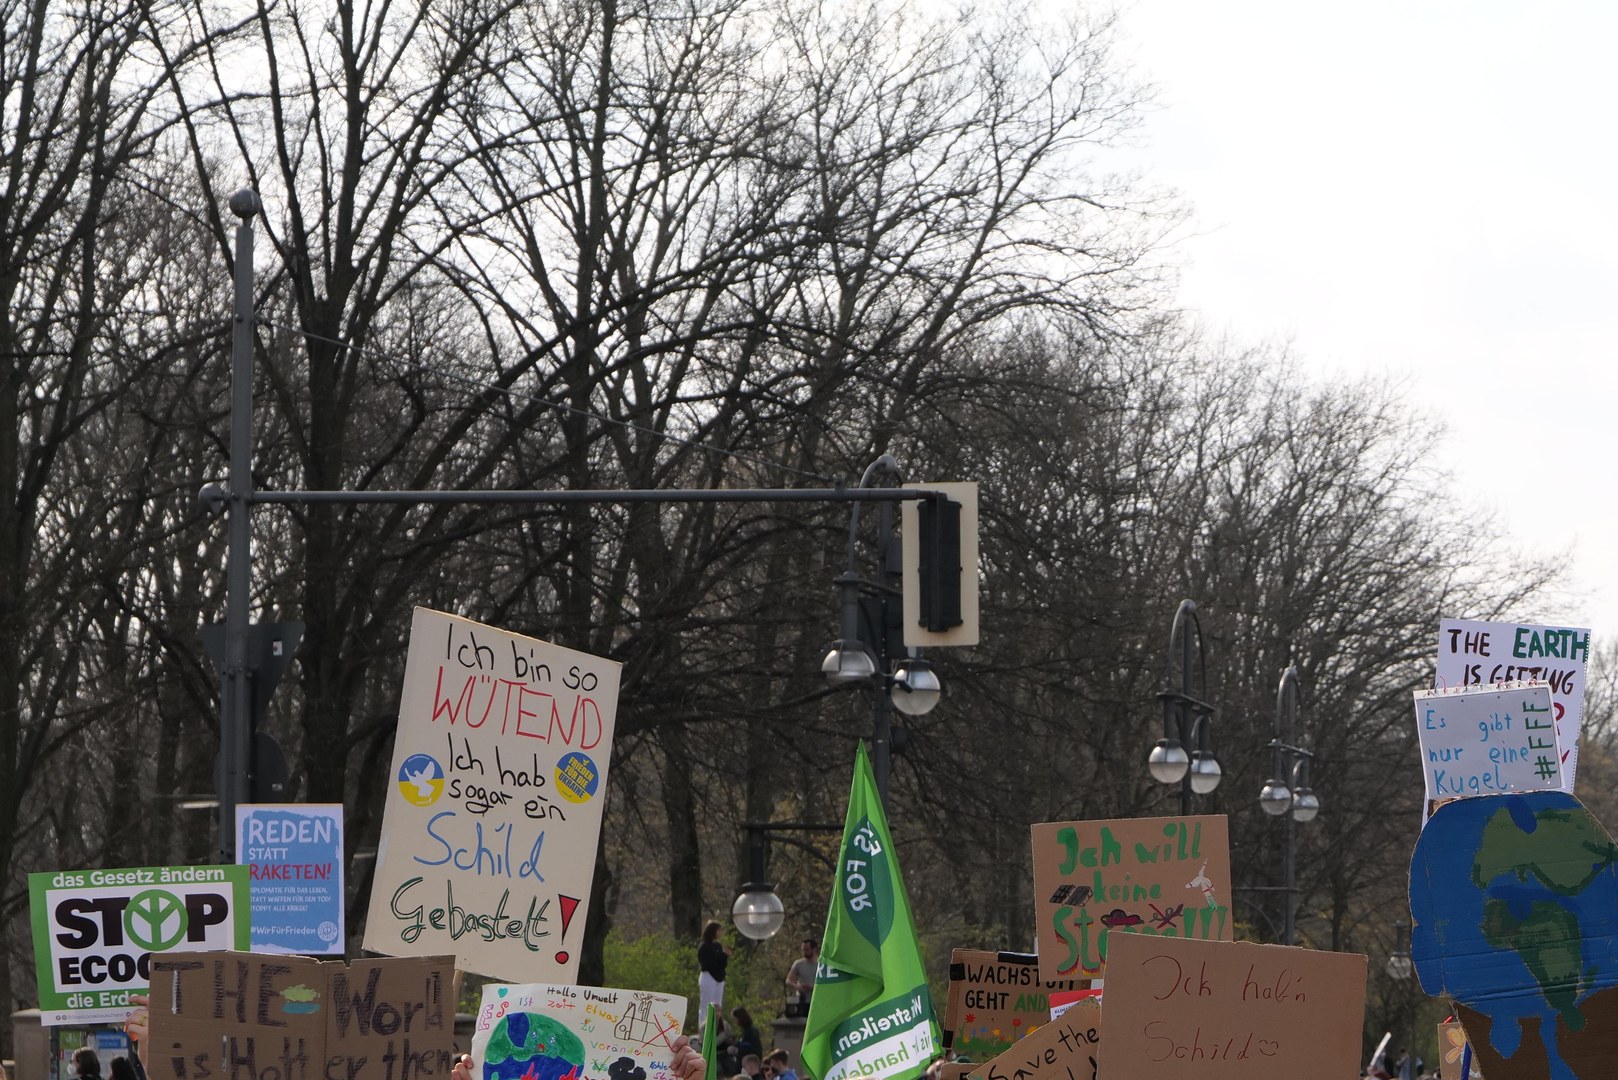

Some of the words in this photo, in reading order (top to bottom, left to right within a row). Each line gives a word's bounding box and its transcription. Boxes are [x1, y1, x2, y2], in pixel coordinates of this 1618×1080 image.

[447, 623, 494, 670] Ich
[511, 640, 551, 683] bin
[562, 665, 599, 692] so
[1448, 629, 1490, 657] THE
[1512, 627, 1589, 663] EARTH
[432, 666, 602, 750] WÜTEND
[1426, 710, 1446, 730] Es
[1478, 712, 1513, 742] gibt
[1523, 701, 1557, 780] #FFF
[447, 732, 484, 776] Ich
[495, 745, 546, 787] hab
[1428, 747, 1464, 762] nur
[1488, 741, 1529, 763] eine
[1433, 764, 1508, 795] Kugel
[524, 795, 566, 821] ein
[248, 819, 331, 845] REDEN
[413, 811, 545, 883] Schild
[1134, 821, 1201, 863] will
[248, 848, 288, 860] STATT
[52, 871, 84, 888] das
[90, 869, 154, 885] Gesetz
[160, 867, 225, 883] ändern
[249, 863, 332, 880] RAKETEN!
[1093, 870, 1162, 904] keine
[55, 889, 229, 950] STOP
[66, 994, 94, 1008] die
[153, 960, 291, 1028] THE
[547, 986, 577, 999] Hallo
[584, 990, 619, 1004] Umwelt
[965, 990, 1010, 1011] GEHT
[1058, 1024, 1100, 1053] the
[1144, 1021, 1254, 1062] Schild
[171, 1042, 212, 1080] is
